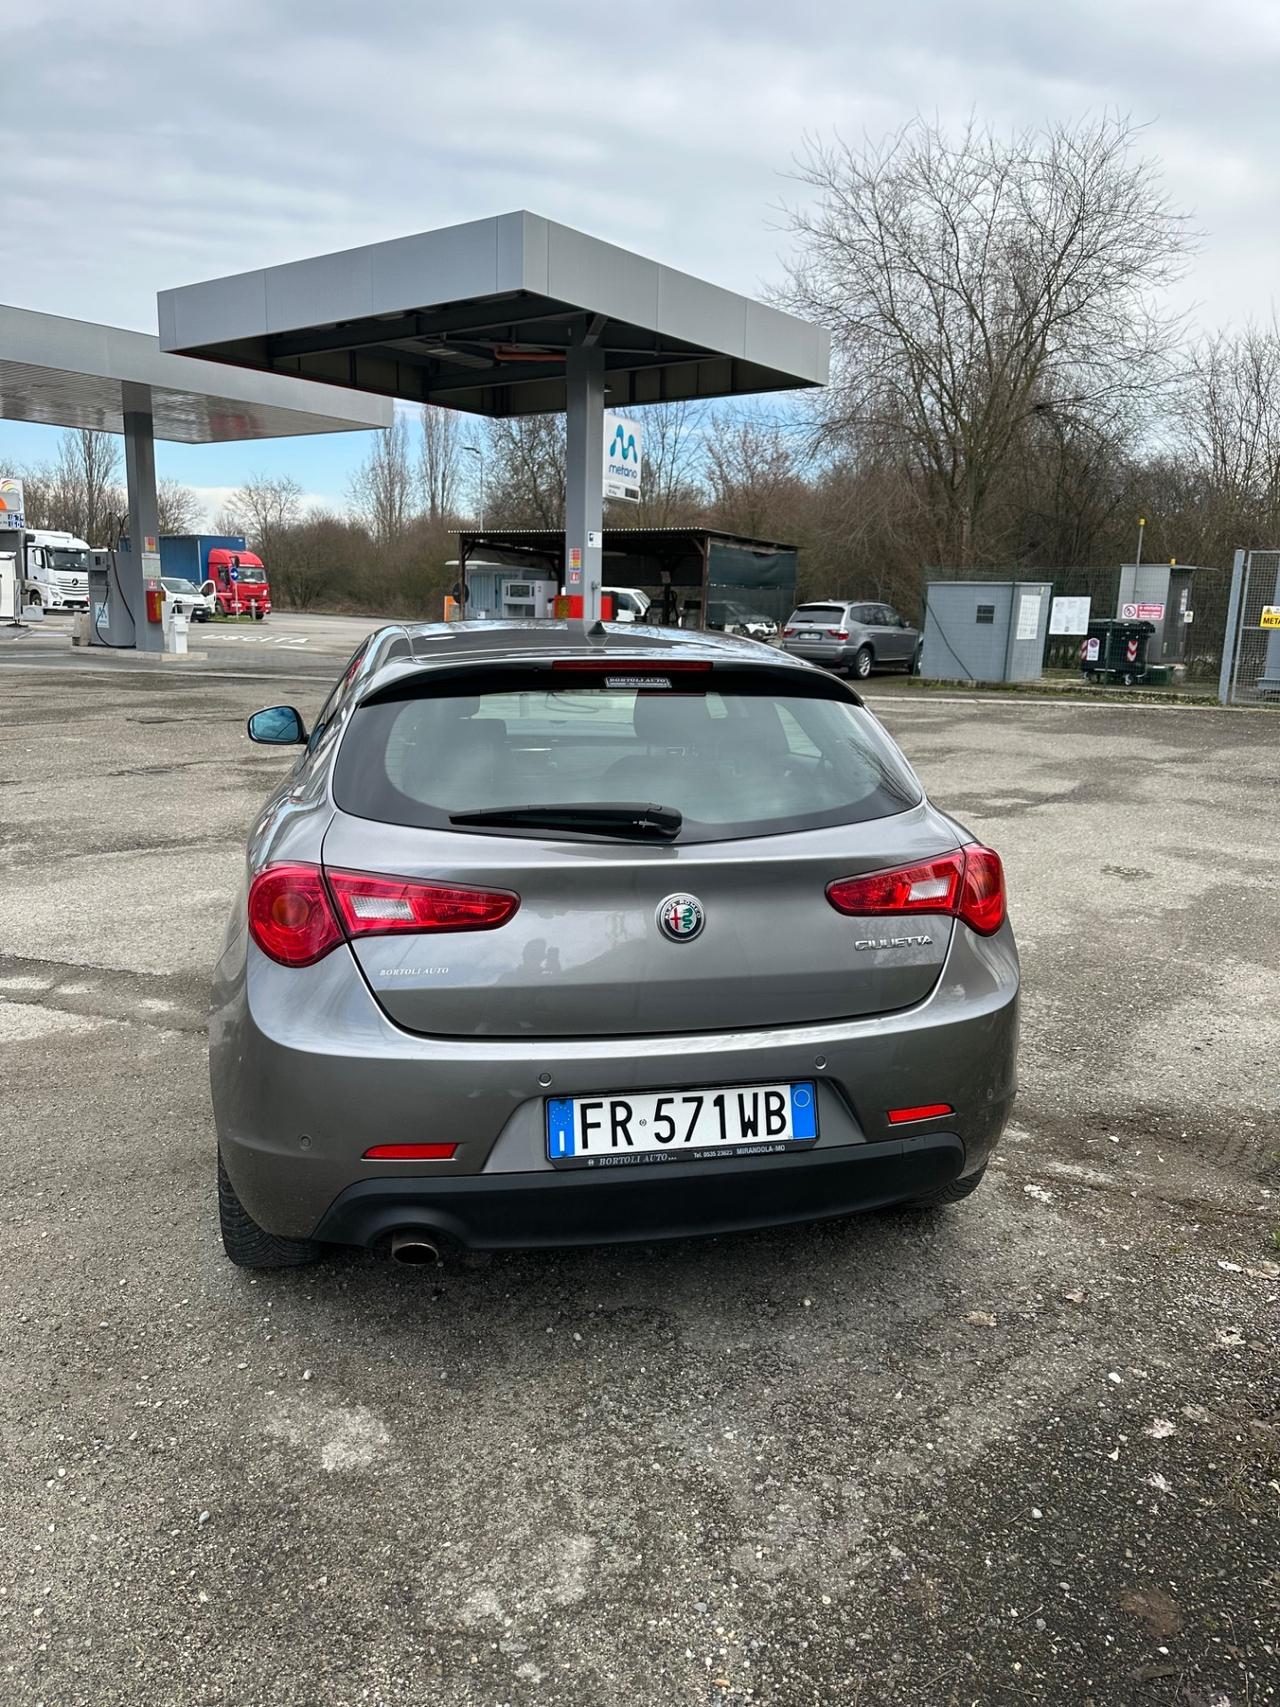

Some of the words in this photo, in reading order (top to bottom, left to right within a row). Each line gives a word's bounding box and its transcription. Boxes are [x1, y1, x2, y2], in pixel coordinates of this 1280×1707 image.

[609, 464, 637, 479] metano
[202, 634, 309, 643] USCITA
[855, 935, 933, 951] GIULIETTA
[380, 968, 421, 976] BORTOLI
[423, 967, 449, 975] AUTO
[580, 1101, 634, 1149] FR
[653, 1091, 787, 1144] 571WB
[600, 1156, 640, 1166] BORTOLI
